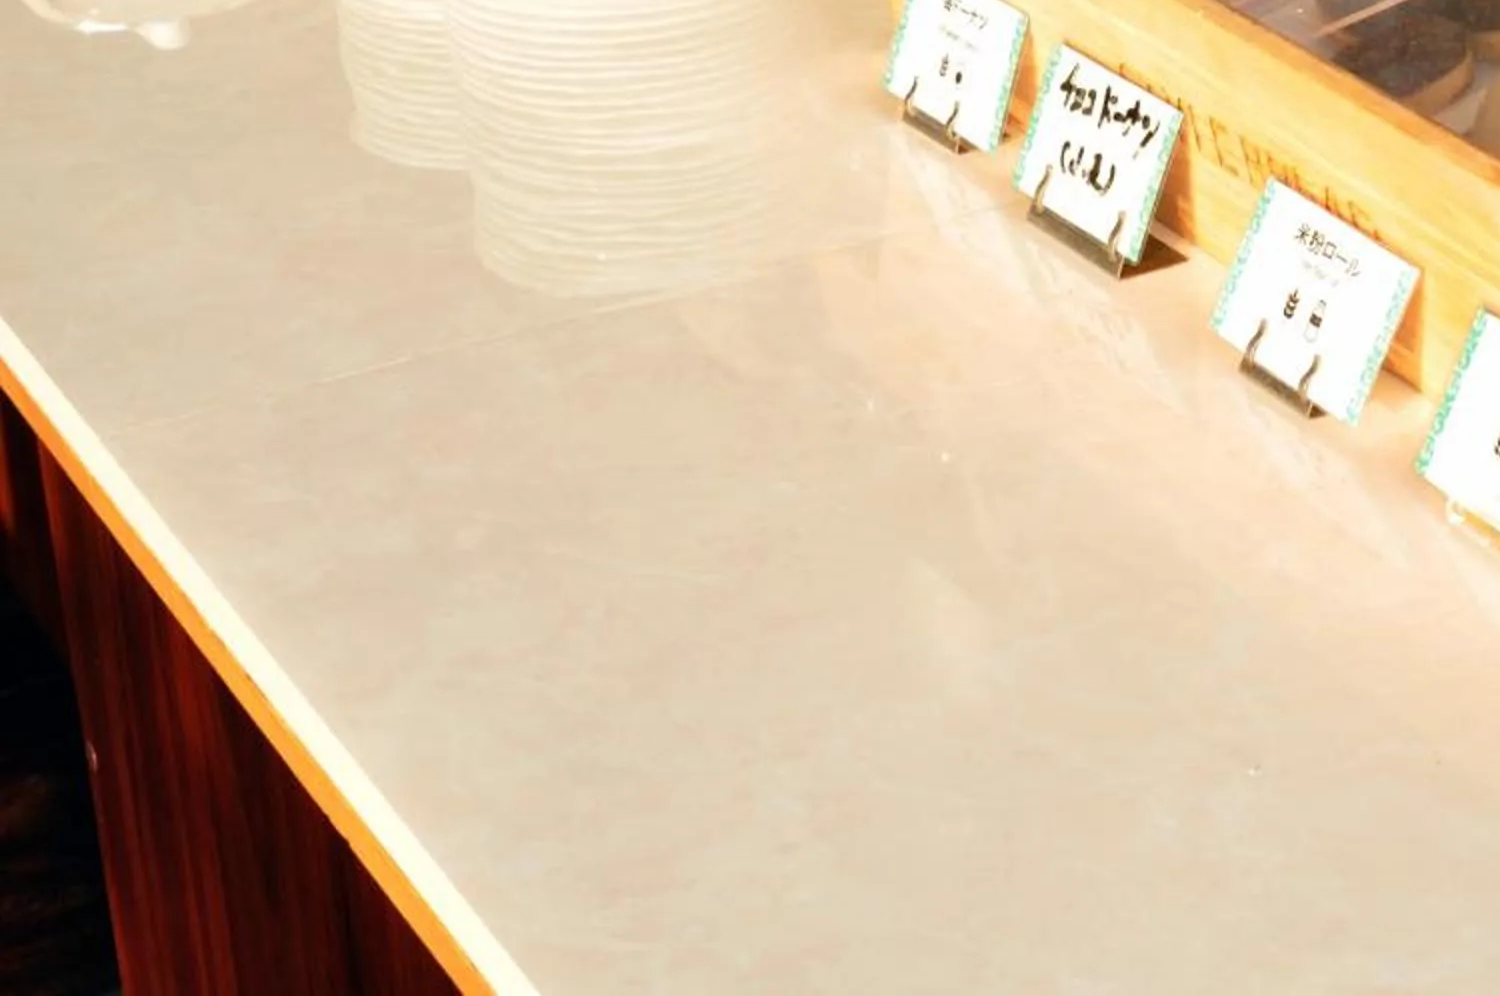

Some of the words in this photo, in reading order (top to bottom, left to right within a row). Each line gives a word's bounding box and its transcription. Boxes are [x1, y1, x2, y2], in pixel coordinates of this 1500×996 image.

[1293, 221, 1362, 279] 米粉ロール
